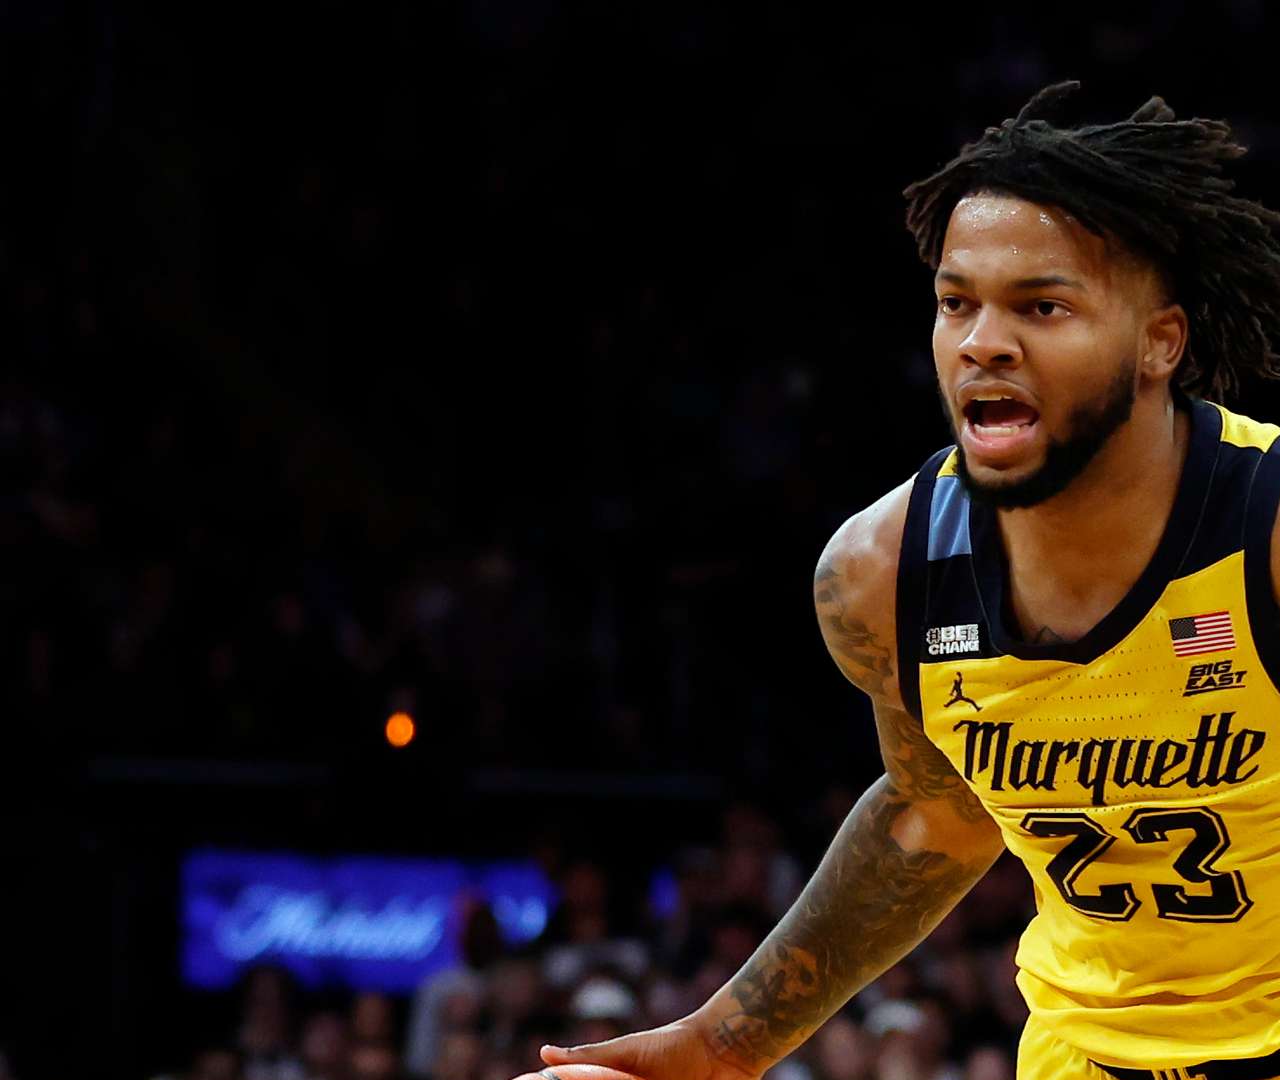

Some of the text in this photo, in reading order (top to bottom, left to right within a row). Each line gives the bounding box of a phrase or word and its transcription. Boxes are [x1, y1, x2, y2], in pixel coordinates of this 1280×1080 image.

[1185, 670, 1247, 691] EAST
[1189, 660, 1232, 677] BIG
[953, 711, 1266, 806] Marquette
[1020, 806, 1254, 923] 23
